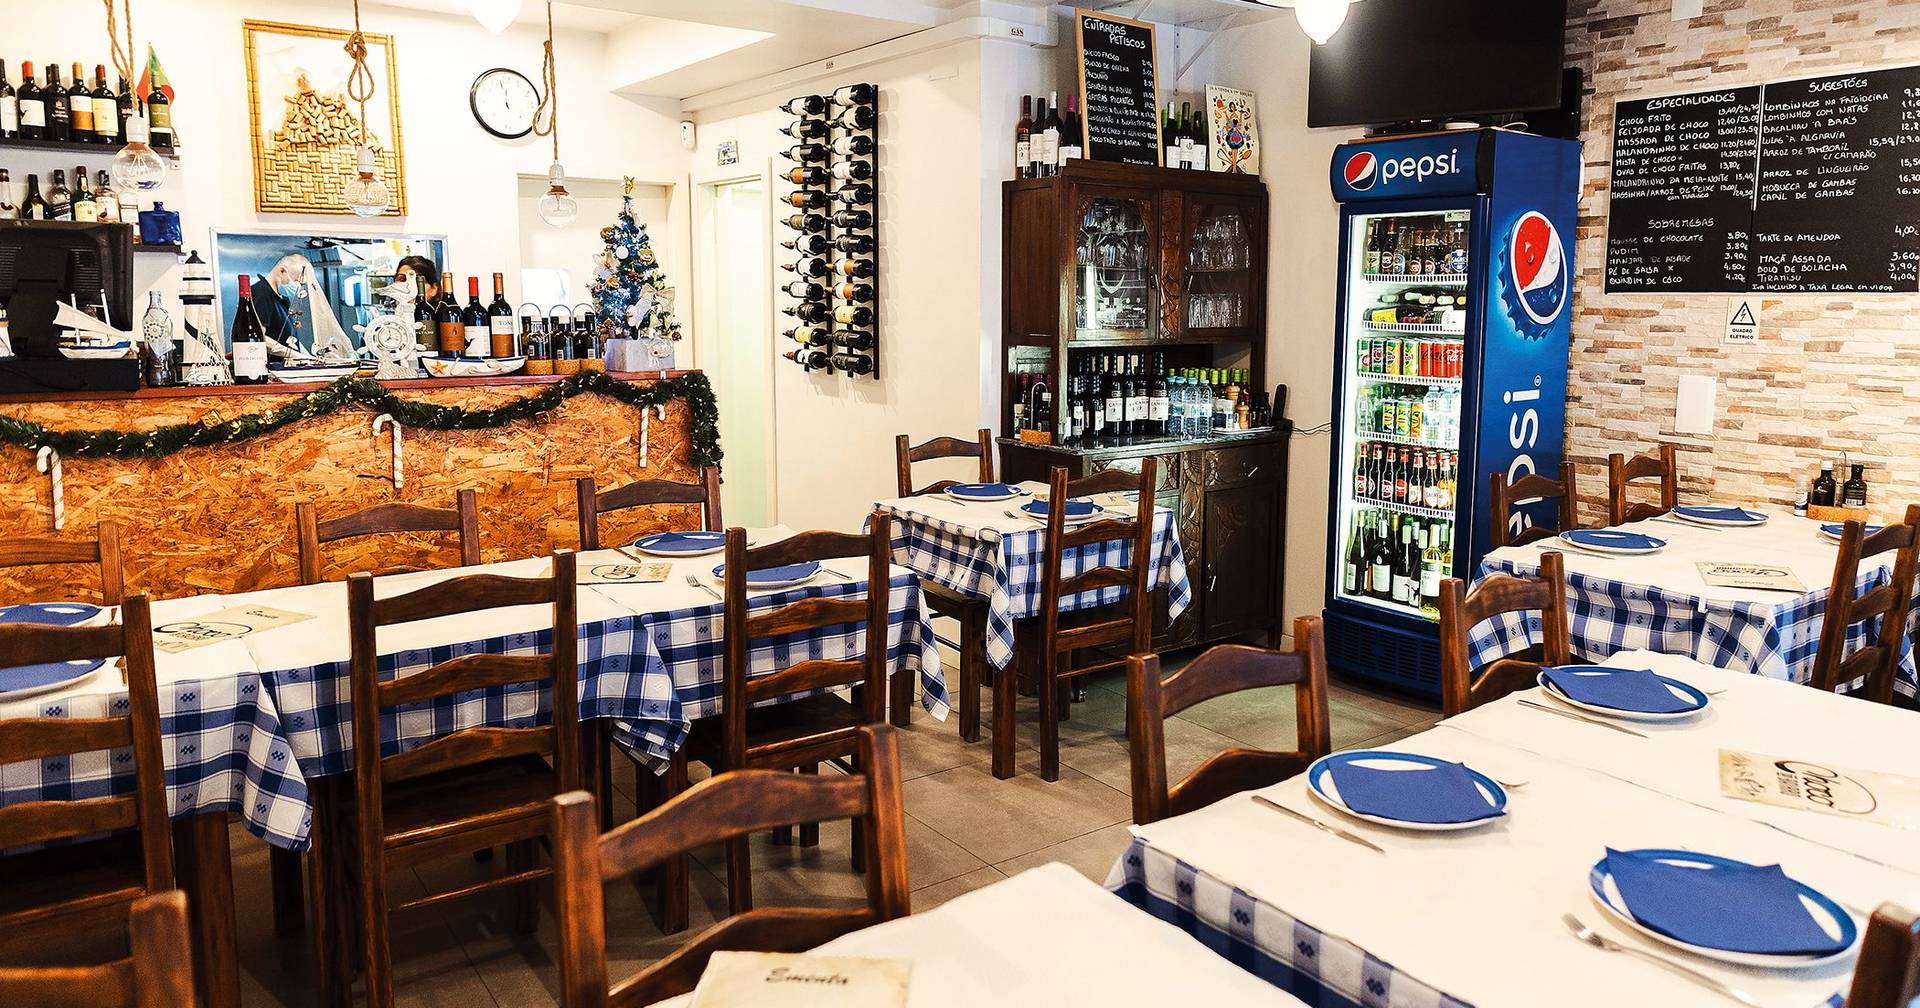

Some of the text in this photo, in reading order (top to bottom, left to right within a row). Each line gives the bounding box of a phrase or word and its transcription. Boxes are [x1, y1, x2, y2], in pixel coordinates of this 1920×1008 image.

[1084, 18, 1126, 35] ENTRADAS
[1109, 33, 1146, 49] PETISCOS
[1646, 92, 1736, 110] ESPECIALIDADES
[1764, 100, 1820, 112] LOMBINHOS
[1763, 110, 1812, 122] LOMBINHOS
[1838, 104, 1869, 115] NATAS
[1619, 118, 1644, 127] CHOCO
[1647, 113, 1672, 123] FRITO
[1619, 125, 1661, 137] FEIJOADA
[1664, 123, 1677, 131] DE
[1680, 121, 1709, 130] CHOCO
[1762, 122, 1809, 134] BACALHAU
[1679, 132, 1710, 141] CHOCO
[1693, 142, 1719, 150] CHOCO
[1653, 155, 1677, 164] CHOCO
[1382, 148, 1459, 184] pepsi
[1616, 168, 1635, 177] OVAS
[1678, 162, 1707, 172] FRITAS
[1647, 218, 1715, 229] SOBREMESAS
[1660, 234, 1705, 243] CHOCOLATE
[1756, 233, 1781, 243] TARTE
[1610, 247, 1639, 256] PUDIM
[1791, 255, 1832, 263] ASSADA
[1801, 263, 1848, 272] BOLACHA
